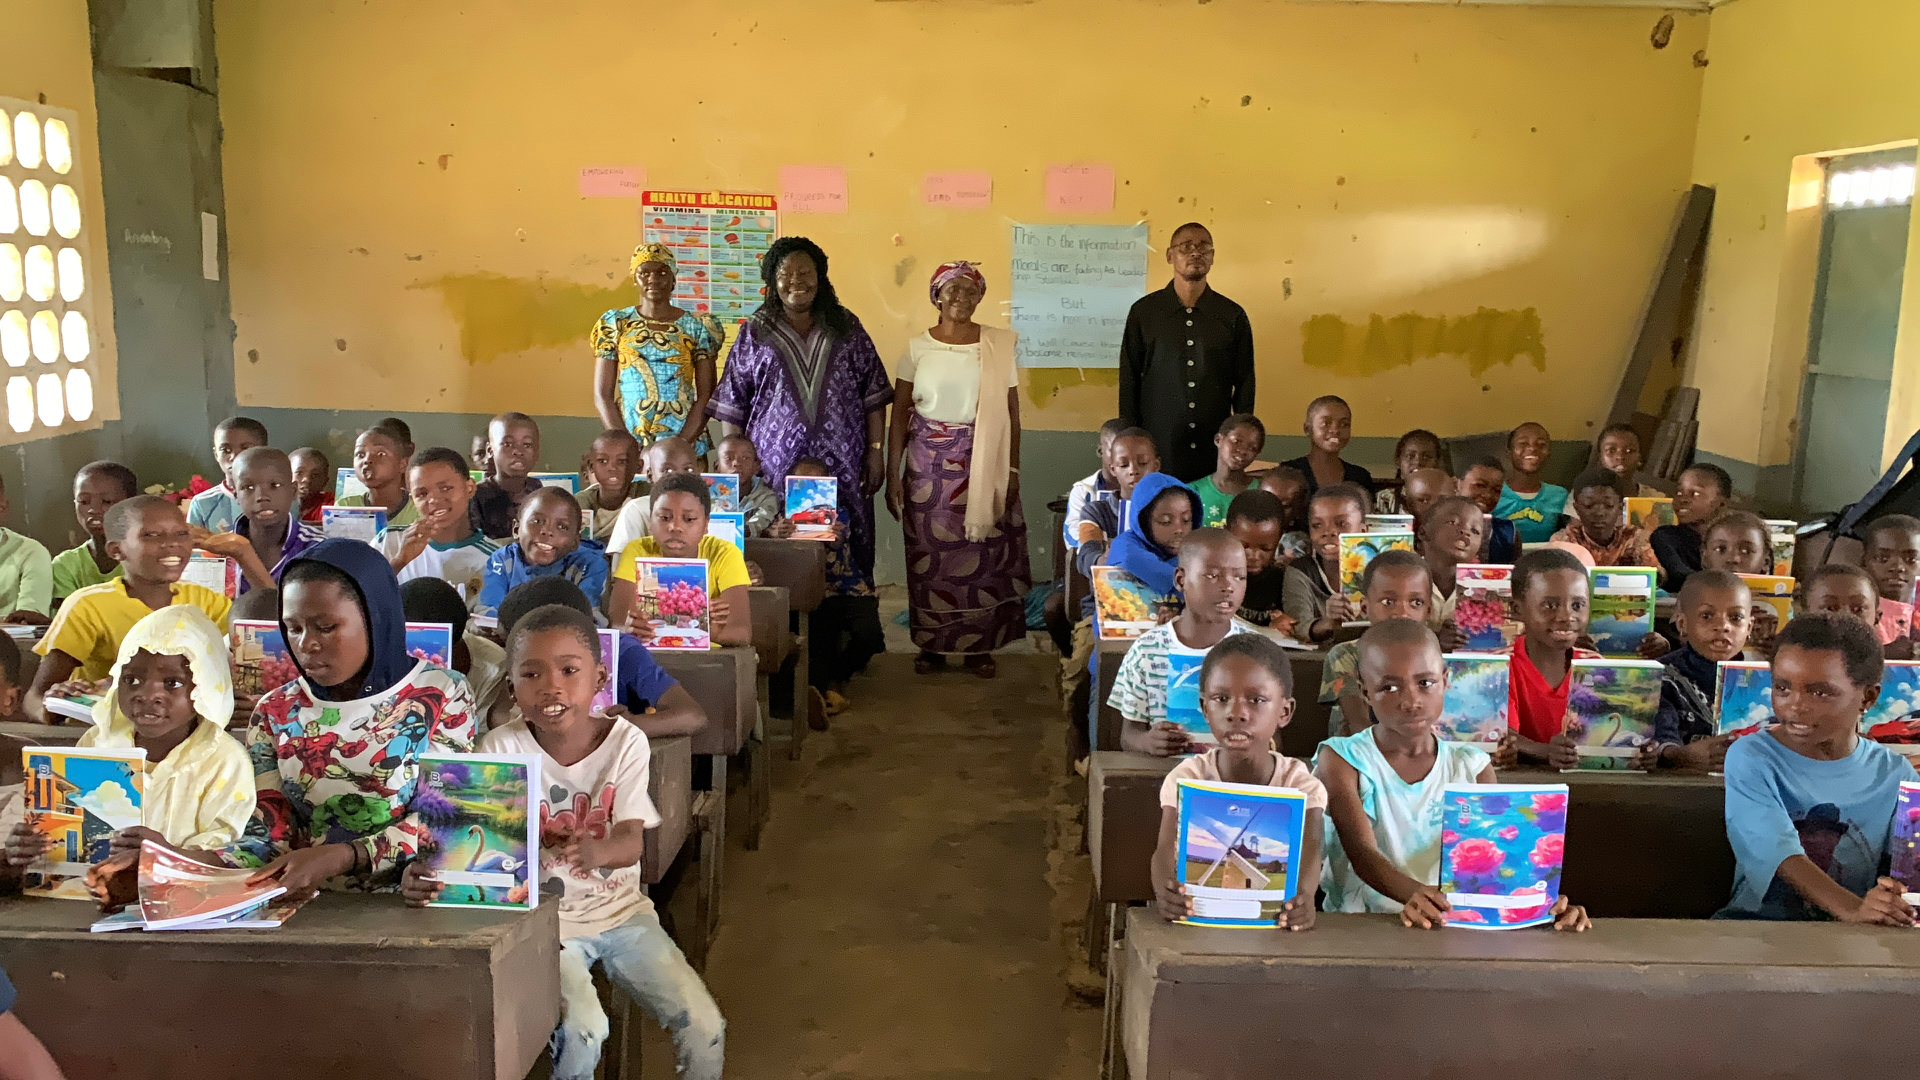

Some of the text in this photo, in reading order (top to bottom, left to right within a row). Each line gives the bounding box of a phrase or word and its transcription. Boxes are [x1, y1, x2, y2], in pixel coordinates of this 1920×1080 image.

[650, 192, 696, 205] HEALTH
[1012, 226, 1041, 247] This
[1060, 234, 1074, 249] the
[1061, 297, 1087, 310] But
